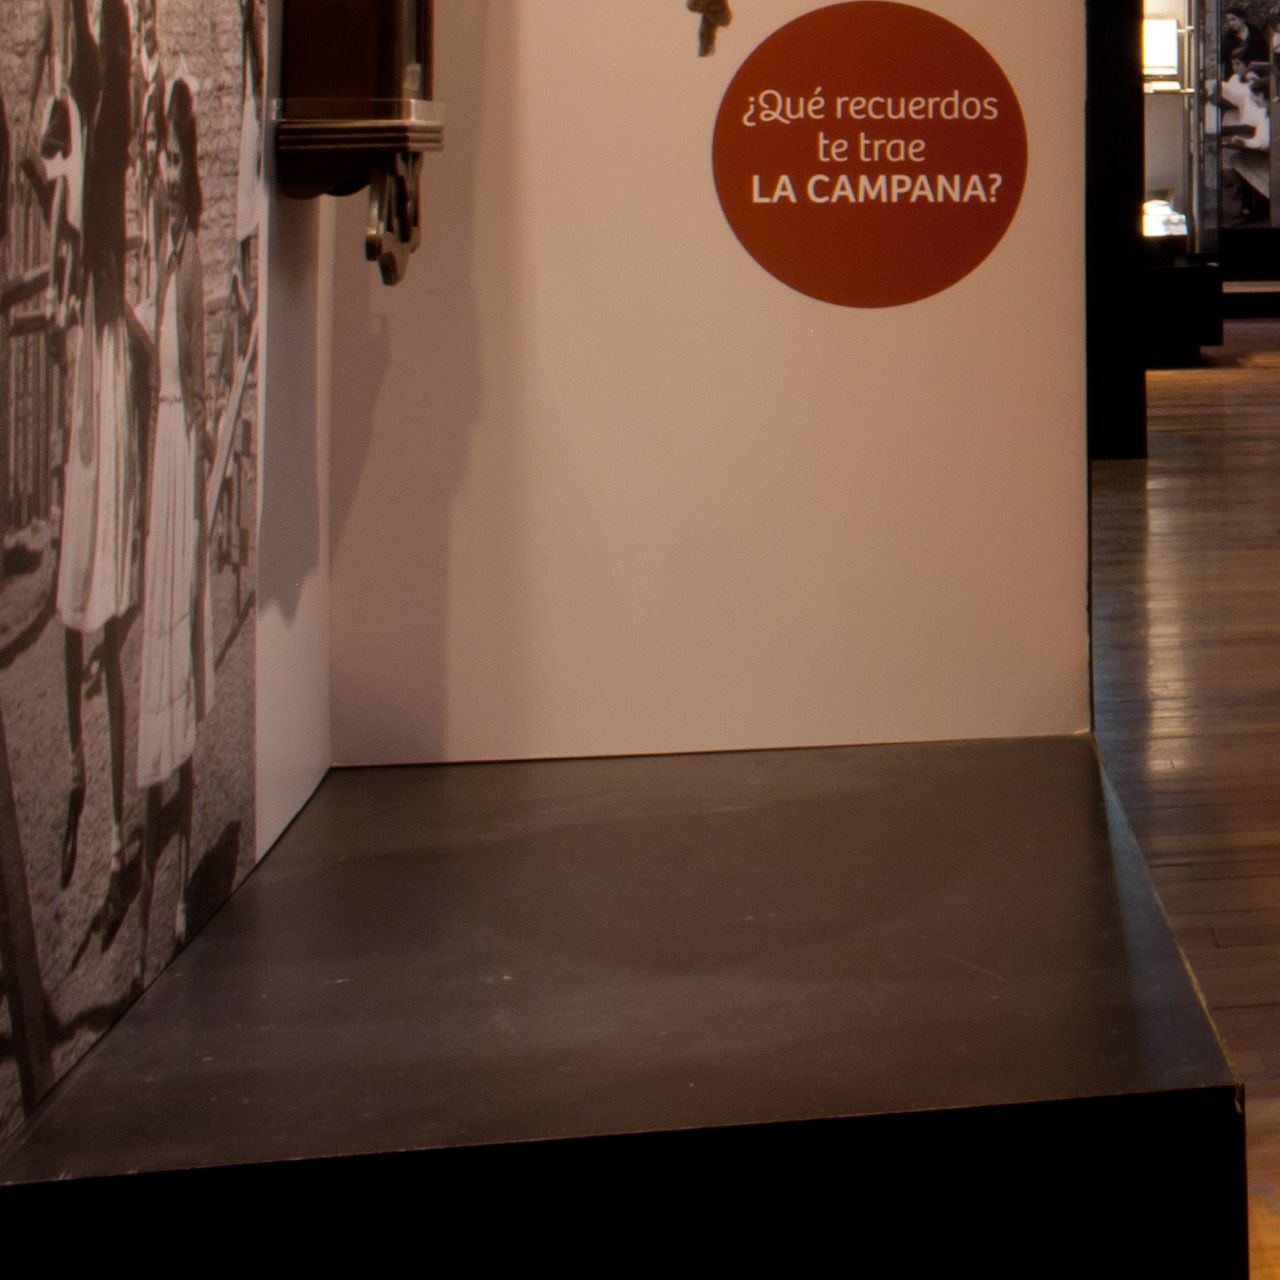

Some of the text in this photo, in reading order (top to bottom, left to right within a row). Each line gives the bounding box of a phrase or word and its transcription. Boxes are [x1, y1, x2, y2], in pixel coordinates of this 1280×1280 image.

[743, 87, 999, 127] ¿Qué recuerdos
[818, 132, 926, 162] te trae
[752, 173, 1003, 204] LA CAMPANA?
